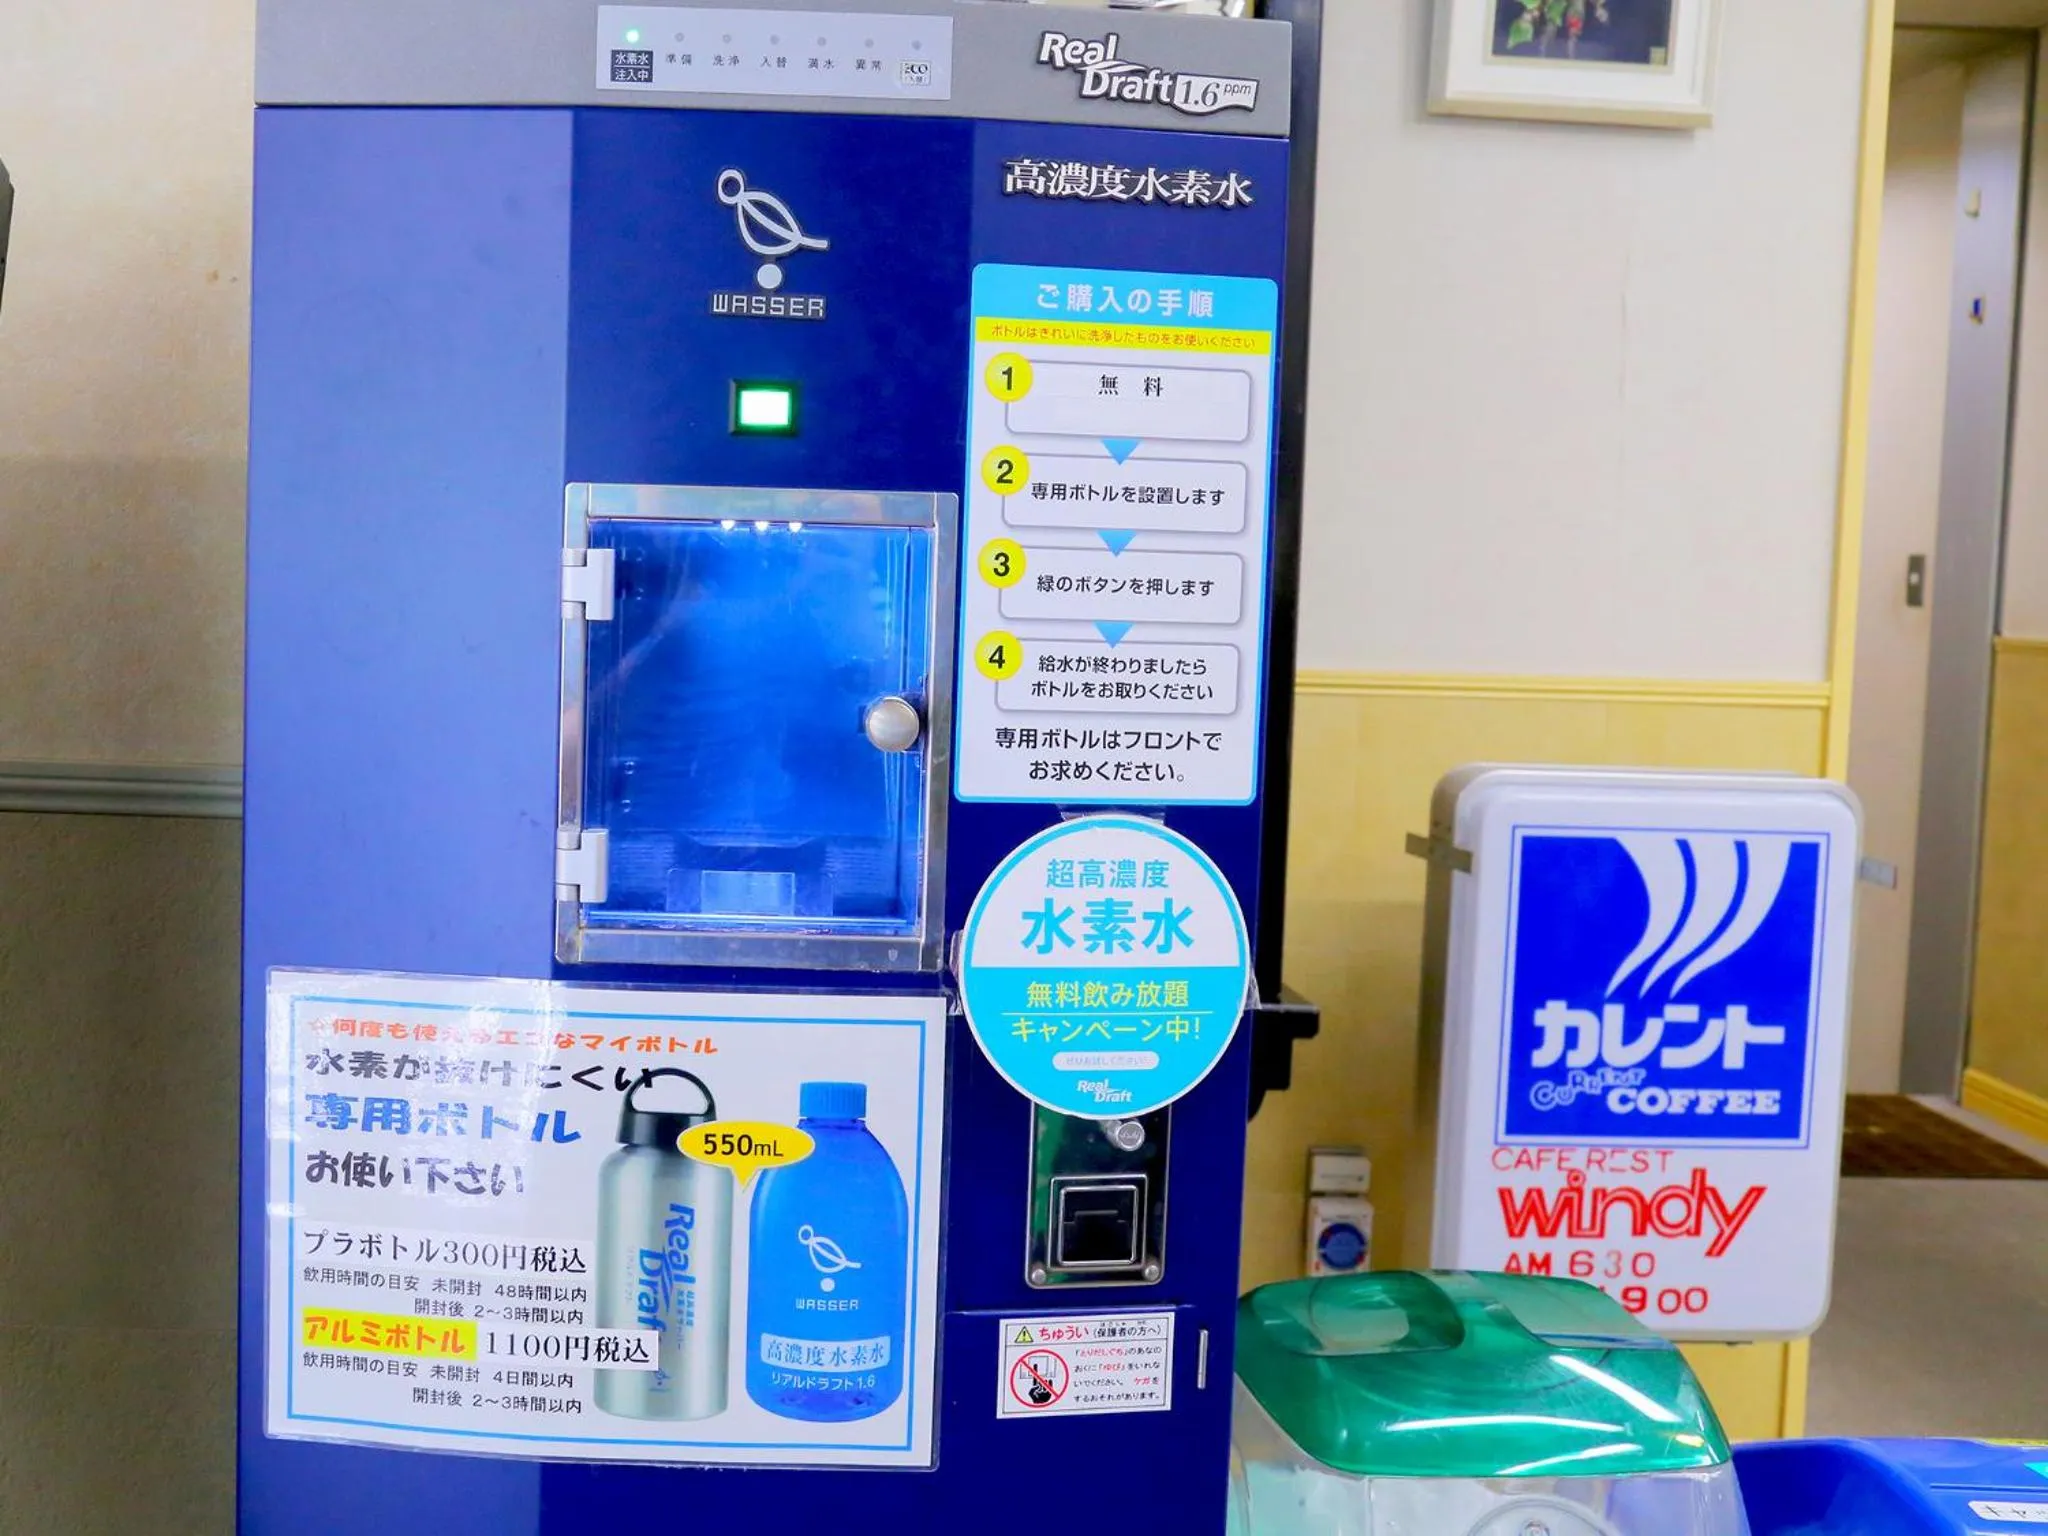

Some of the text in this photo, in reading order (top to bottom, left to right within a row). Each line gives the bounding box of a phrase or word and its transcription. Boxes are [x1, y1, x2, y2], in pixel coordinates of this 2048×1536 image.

[614, 53, 650, 65] 水素水
[665, 54, 693, 66] 準備
[713, 55, 740, 66] 洗浄
[1039, 31, 1118, 68] Real
[760, 56, 788, 68] 入替
[614, 69, 650, 81] 注入中
[1082, 68, 1252, 107] Draft 1.6 ppm
[1004, 159, 1252, 206] 高濃度水素水
[712, 294, 825, 317] WASSER
[1036, 283, 1215, 319] ご購入の手順
[990, 325, 1256, 348] ボトルはきれいに洗浄したものをお使いください
[1001, 366, 1013, 391] 1
[996, 459, 1013, 485] 2
[1031, 482, 1226, 506] 専用ボトルを設置します
[992, 552, 1011, 577] 3
[1036, 575, 1215, 597] 緑のボタンを押します
[988, 645, 1006, 669] 4
[1038, 655, 1207, 676] 給水が終わりましたら
[1031, 681, 1214, 700] ボトルをお取りください
[995, 727, 1223, 751] 専用ボトルはフロントで
[1029, 761, 1186, 782] お求めください。
[1046, 859, 1170, 889] 超高濃度
[1021, 897, 1195, 955] 水素水
[1026, 980, 1190, 1009] 無料飲み放題
[1531, 1000, 1787, 1069] カレント
[1076, 1079, 1110, 1093] Real
[1093, 1089, 1133, 1103] Draft
[1606, 1086, 1782, 1116] COFFEE
[304, 1092, 583, 1144] 専用ボトル
[703, 1133, 784, 1157] 550mL
[1491, 1149, 1577, 1172] CAFE
[305, 1150, 525, 1197] お使い下さい
[1497, 1168, 1768, 1257] windy
[303, 1230, 588, 1274] プラボトル300円税込
[664, 1203, 697, 1286] Real
[1503, 1252, 1552, 1276] AM
[303, 1266, 588, 1303] 飲用時間の目安 未開封 48時間以内
[637, 1248, 667, 1336] Draf
[414, 1298, 464, 1318] 開封後
[795, 1298, 859, 1311] WASSER
[303, 1315, 650, 1364] アルミボトル 1100円税込
[1038, 1326, 1089, 1341] ちゅうい
[766, 1340, 885, 1368] 高濃度水素水
[303, 1350, 574, 1389] 飲用時間の目安 未開封 4日間以内
[412, 1387, 463, 1408] 開封後
